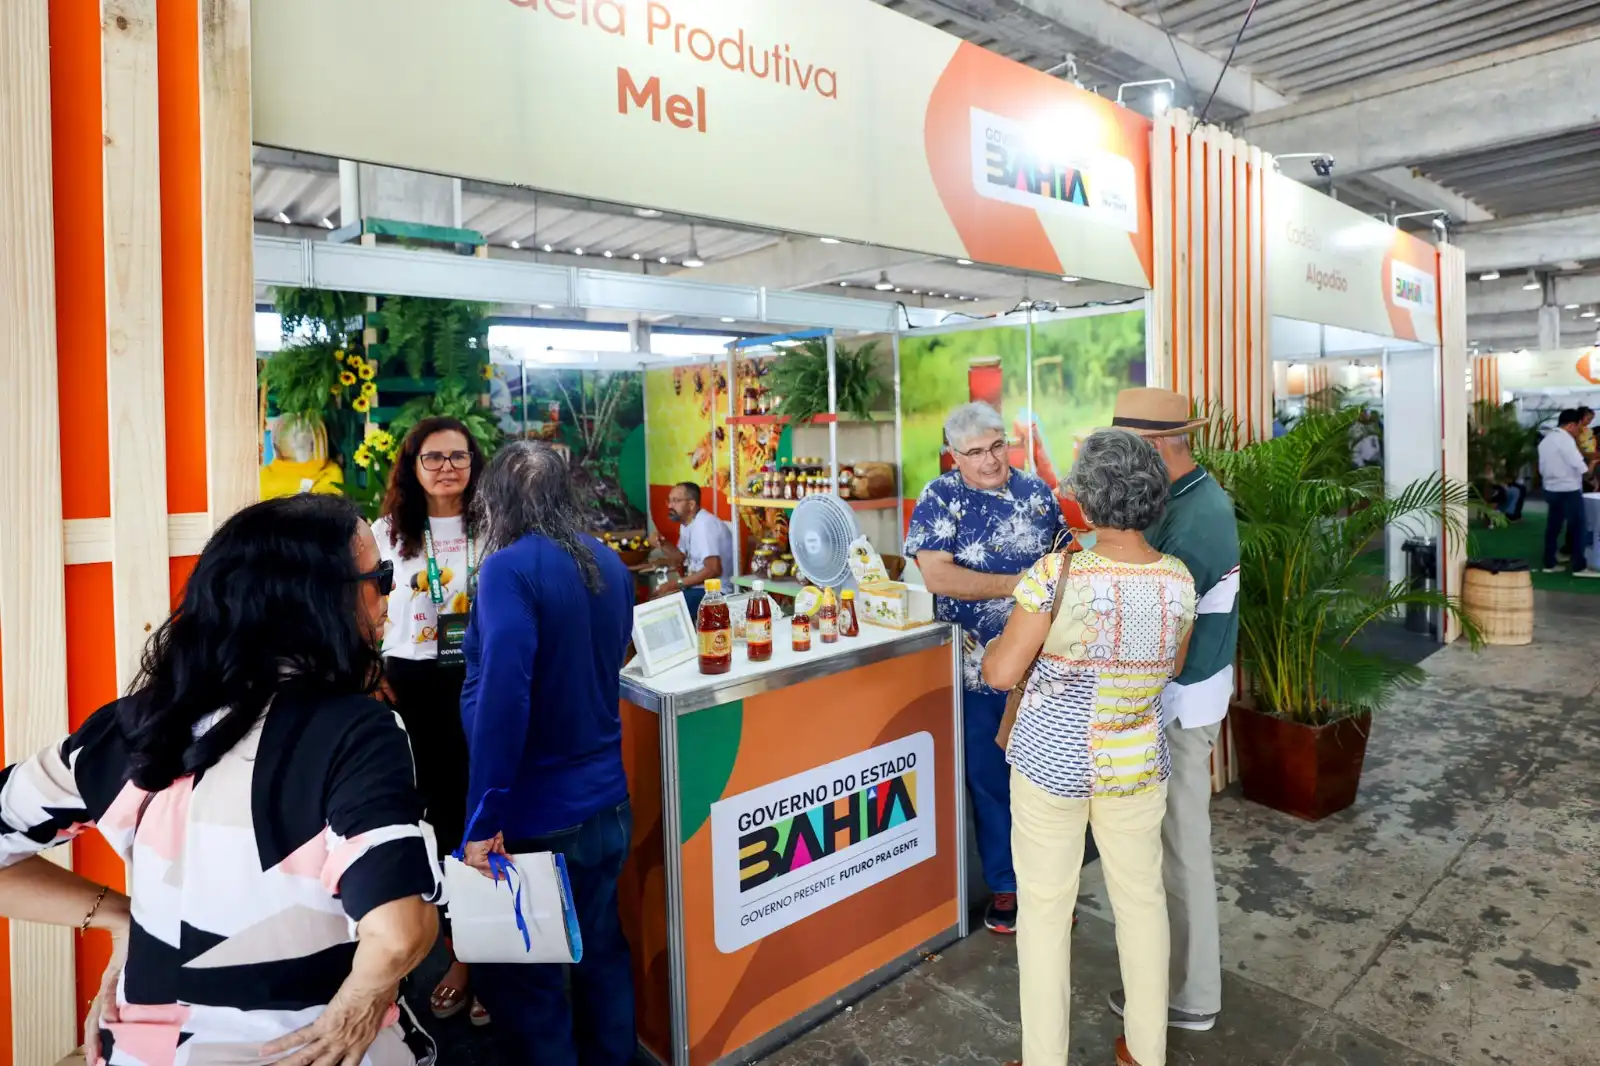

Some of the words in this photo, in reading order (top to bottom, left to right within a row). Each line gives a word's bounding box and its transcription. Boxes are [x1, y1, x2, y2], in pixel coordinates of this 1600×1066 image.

[646, 2, 838, 99] Produtiva
[616, 66, 707, 132] Mel
[985, 142, 1090, 207] BAHIA
[1306, 263, 1348, 292] Algodão
[738, 785, 827, 832] GOVERNO
[833, 774, 856, 796] DO
[861, 752, 917, 786] ESTADO
[738, 770, 918, 893] BAHIA
[740, 896, 792, 926] GOVERNO
[793, 875, 836, 902] PRESENTE
[839, 857, 874, 881] FUTURO
[875, 850, 892, 867] PRA
[892, 838, 919, 857] GENTE
